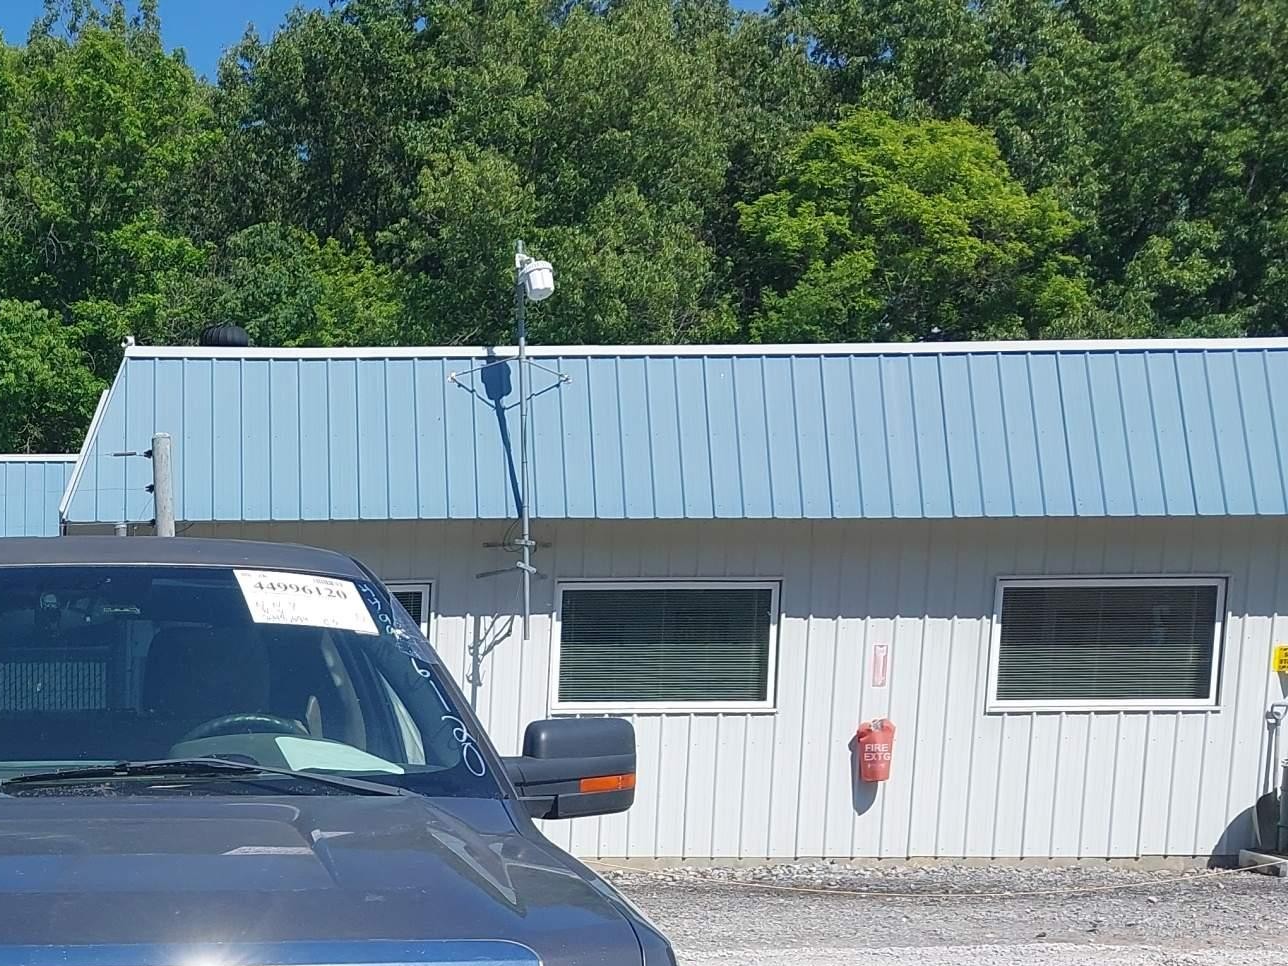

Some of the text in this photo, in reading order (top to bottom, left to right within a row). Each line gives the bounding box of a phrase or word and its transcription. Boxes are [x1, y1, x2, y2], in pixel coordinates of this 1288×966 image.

[253, 580, 348, 600] 44996120
[865, 744, 889, 752] FIRE
[864, 752, 891, 761] EXTG
